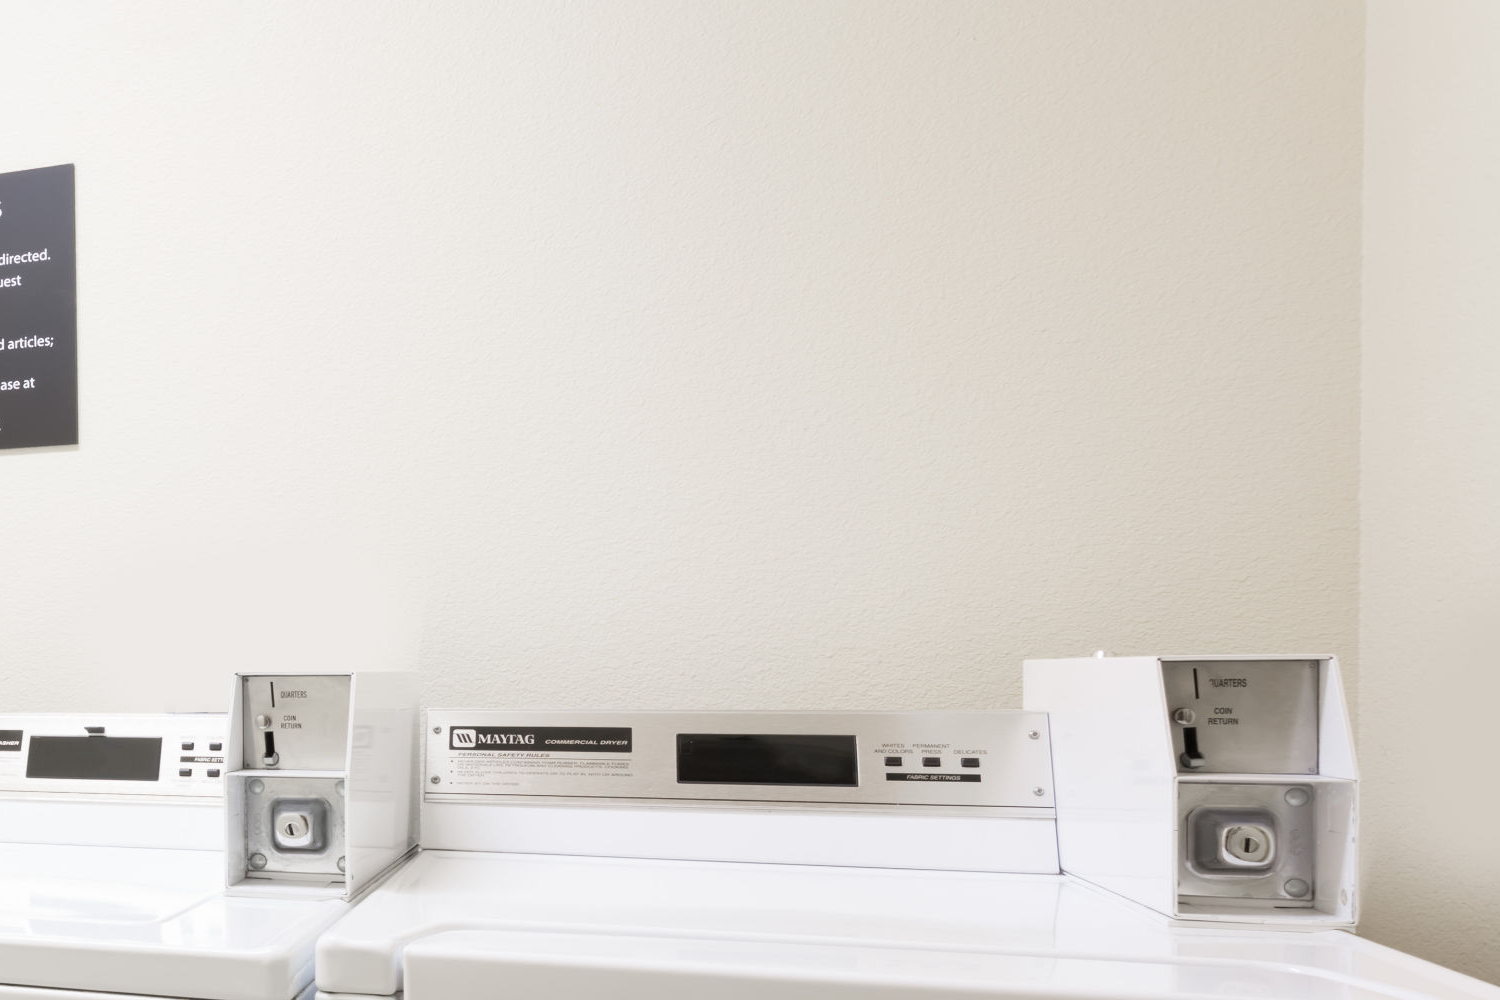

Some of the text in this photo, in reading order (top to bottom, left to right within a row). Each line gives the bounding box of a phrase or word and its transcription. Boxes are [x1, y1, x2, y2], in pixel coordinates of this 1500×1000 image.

[7, 334, 54, 350] articles;
[22, 377, 36, 389] at
[280, 690, 308, 699] QUARTERS
[1213, 707, 1233, 715] COIN
[1207, 717, 1239, 725] RETURN
[477, 734, 535, 745] MAYTAG
